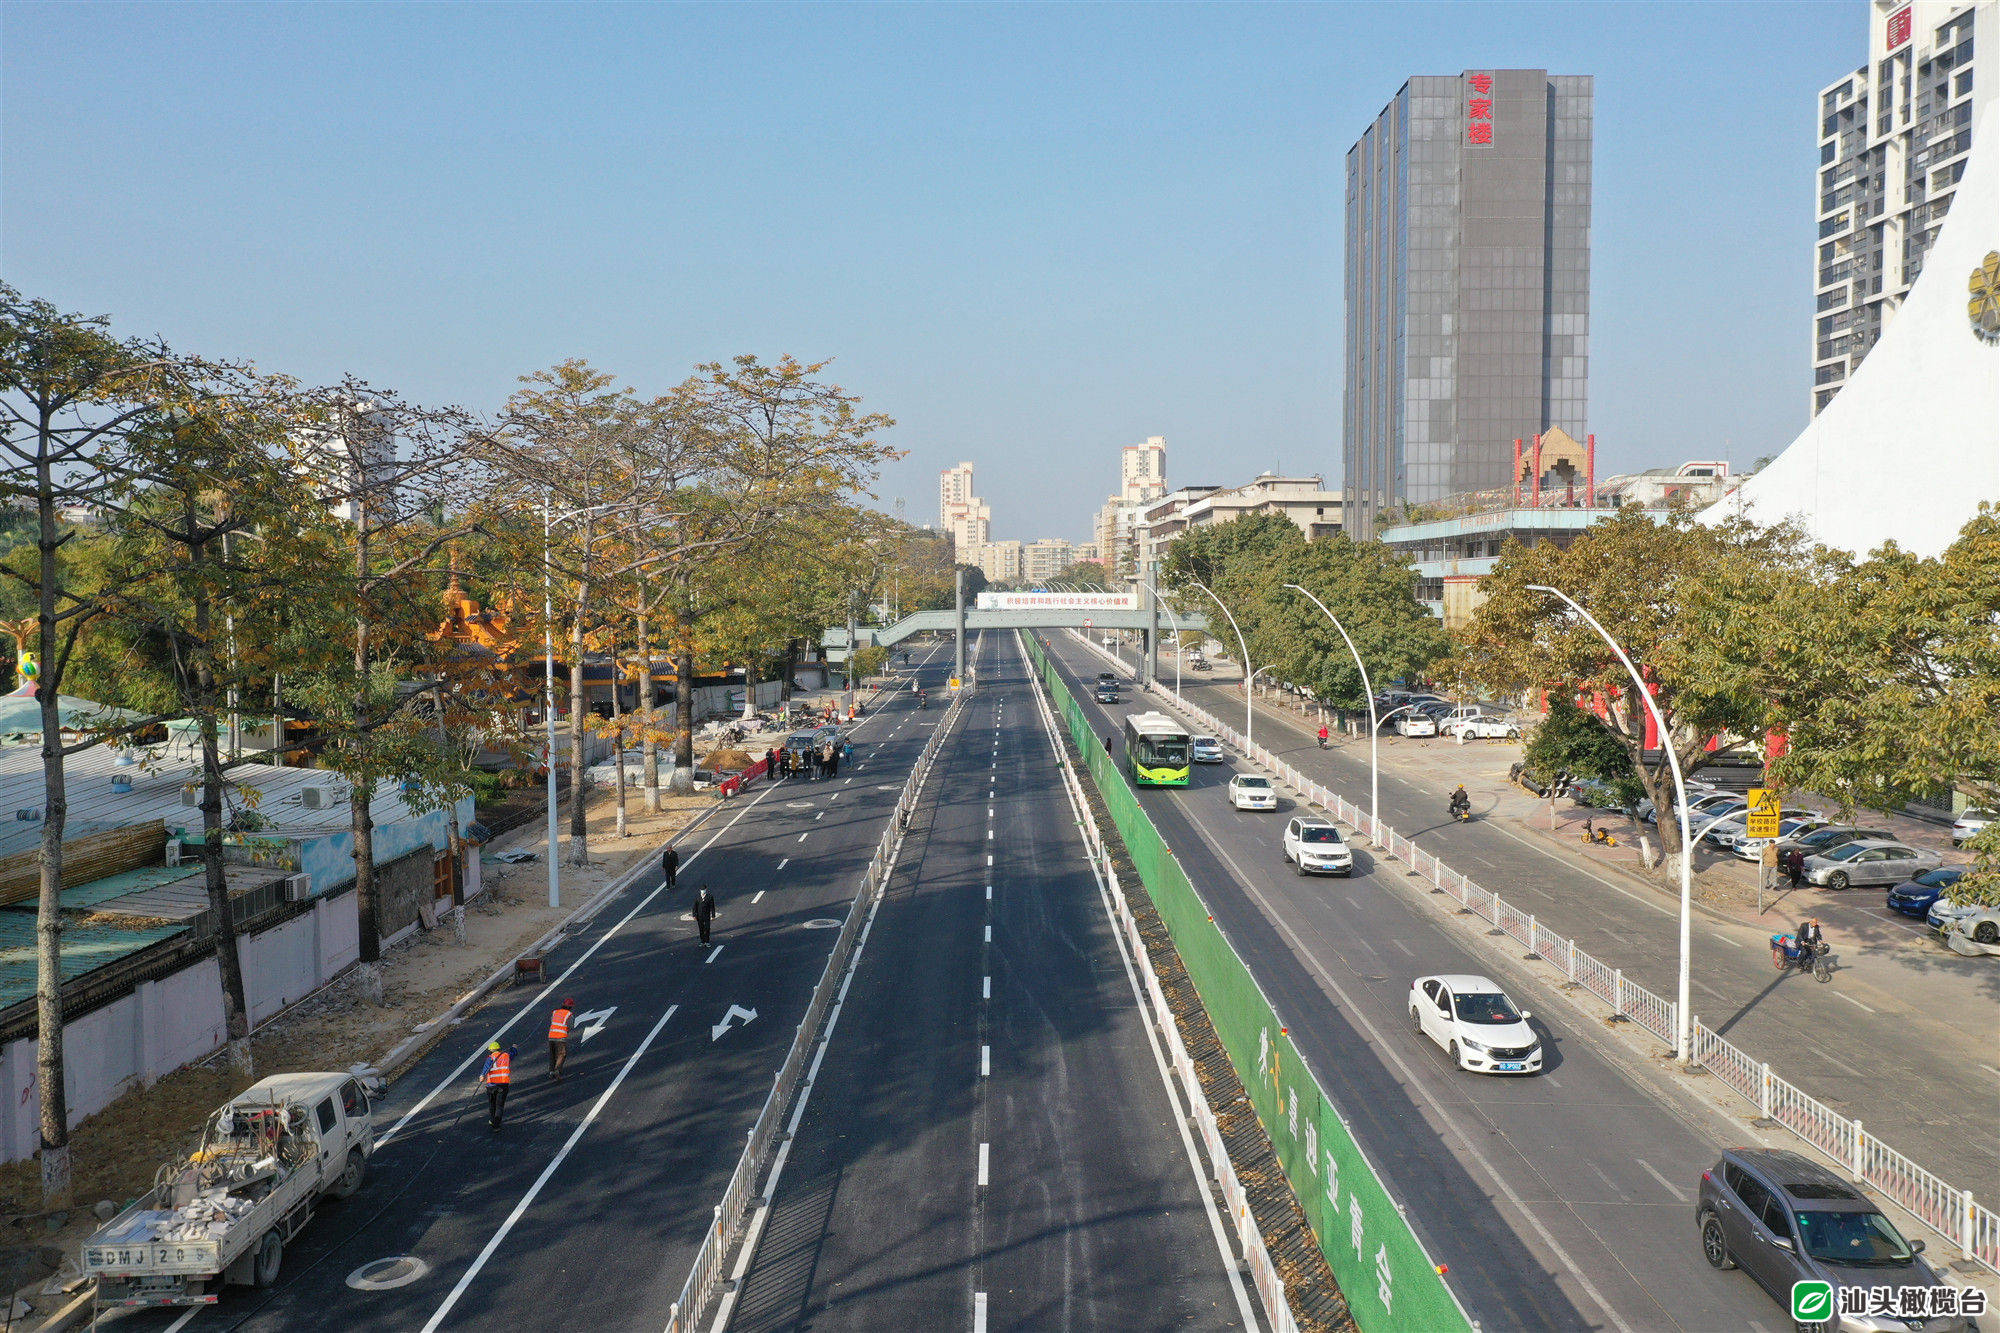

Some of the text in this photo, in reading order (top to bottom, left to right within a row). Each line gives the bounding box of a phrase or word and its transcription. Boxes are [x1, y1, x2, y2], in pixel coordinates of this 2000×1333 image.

[1467, 73, 1494, 145] 专家楼
[1006, 597, 1129, 606] 积极培育和践行社会主义核心价值观
